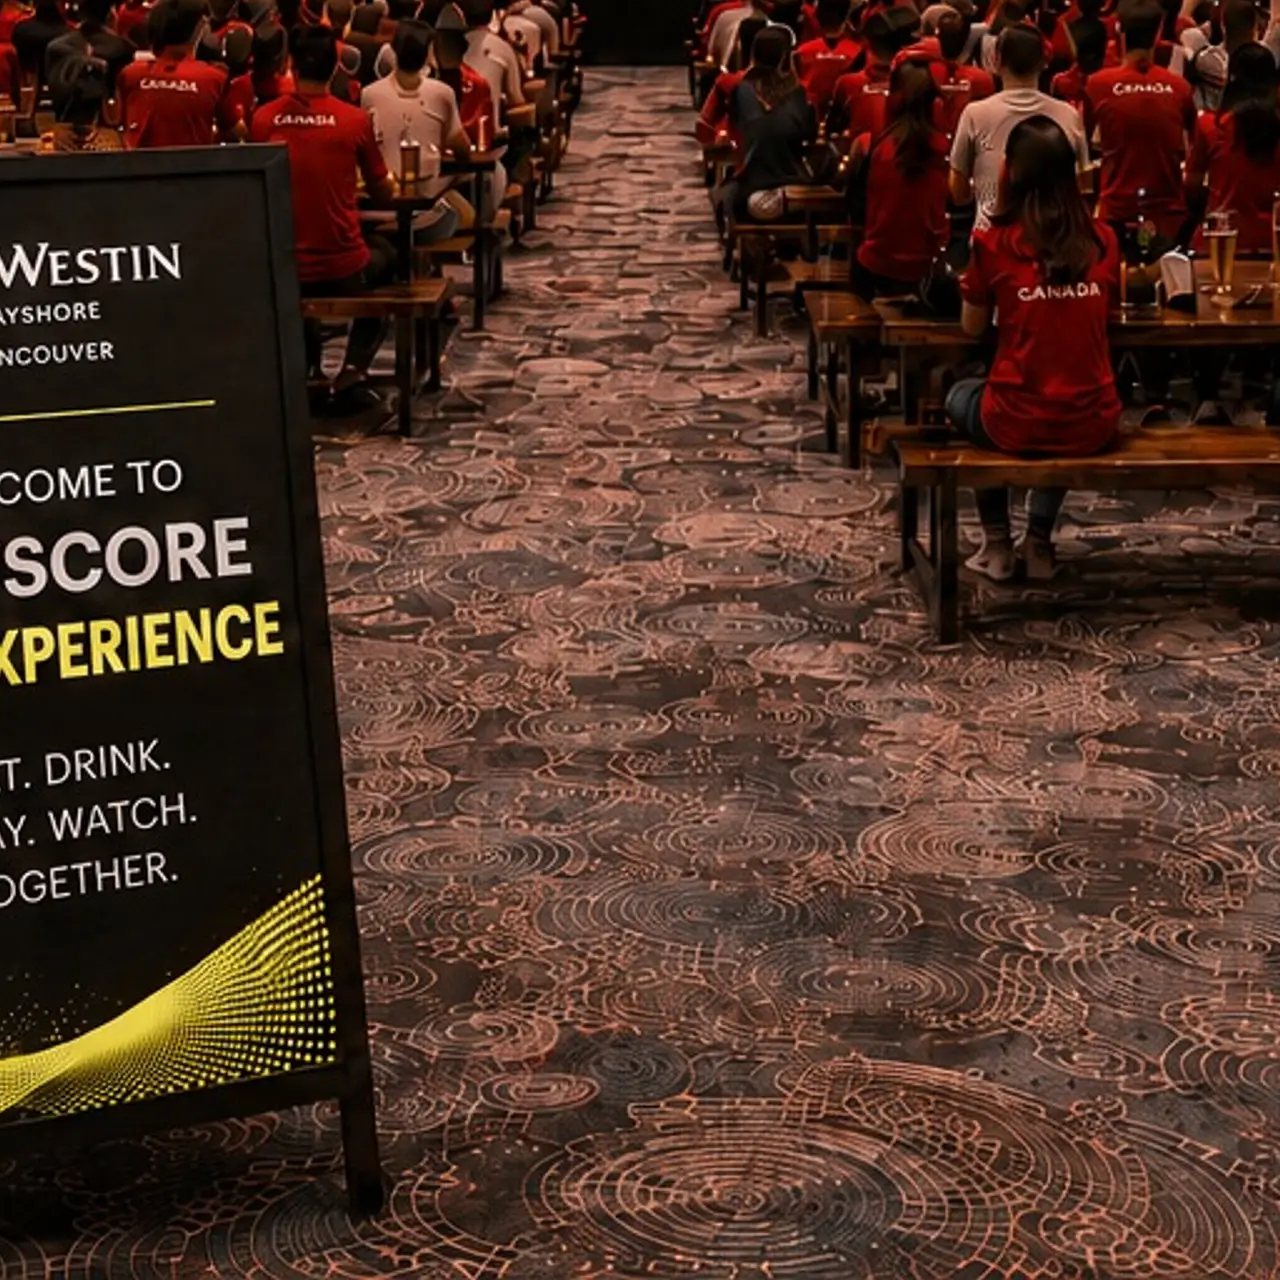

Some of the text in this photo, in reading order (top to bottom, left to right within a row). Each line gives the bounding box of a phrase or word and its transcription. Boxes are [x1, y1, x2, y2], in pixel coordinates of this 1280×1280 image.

[1017, 281, 1101, 302] CANADA
[126, 458, 183, 495] TO
[44, 737, 171, 787] DRINK.
[46, 792, 198, 842] WATCH.
